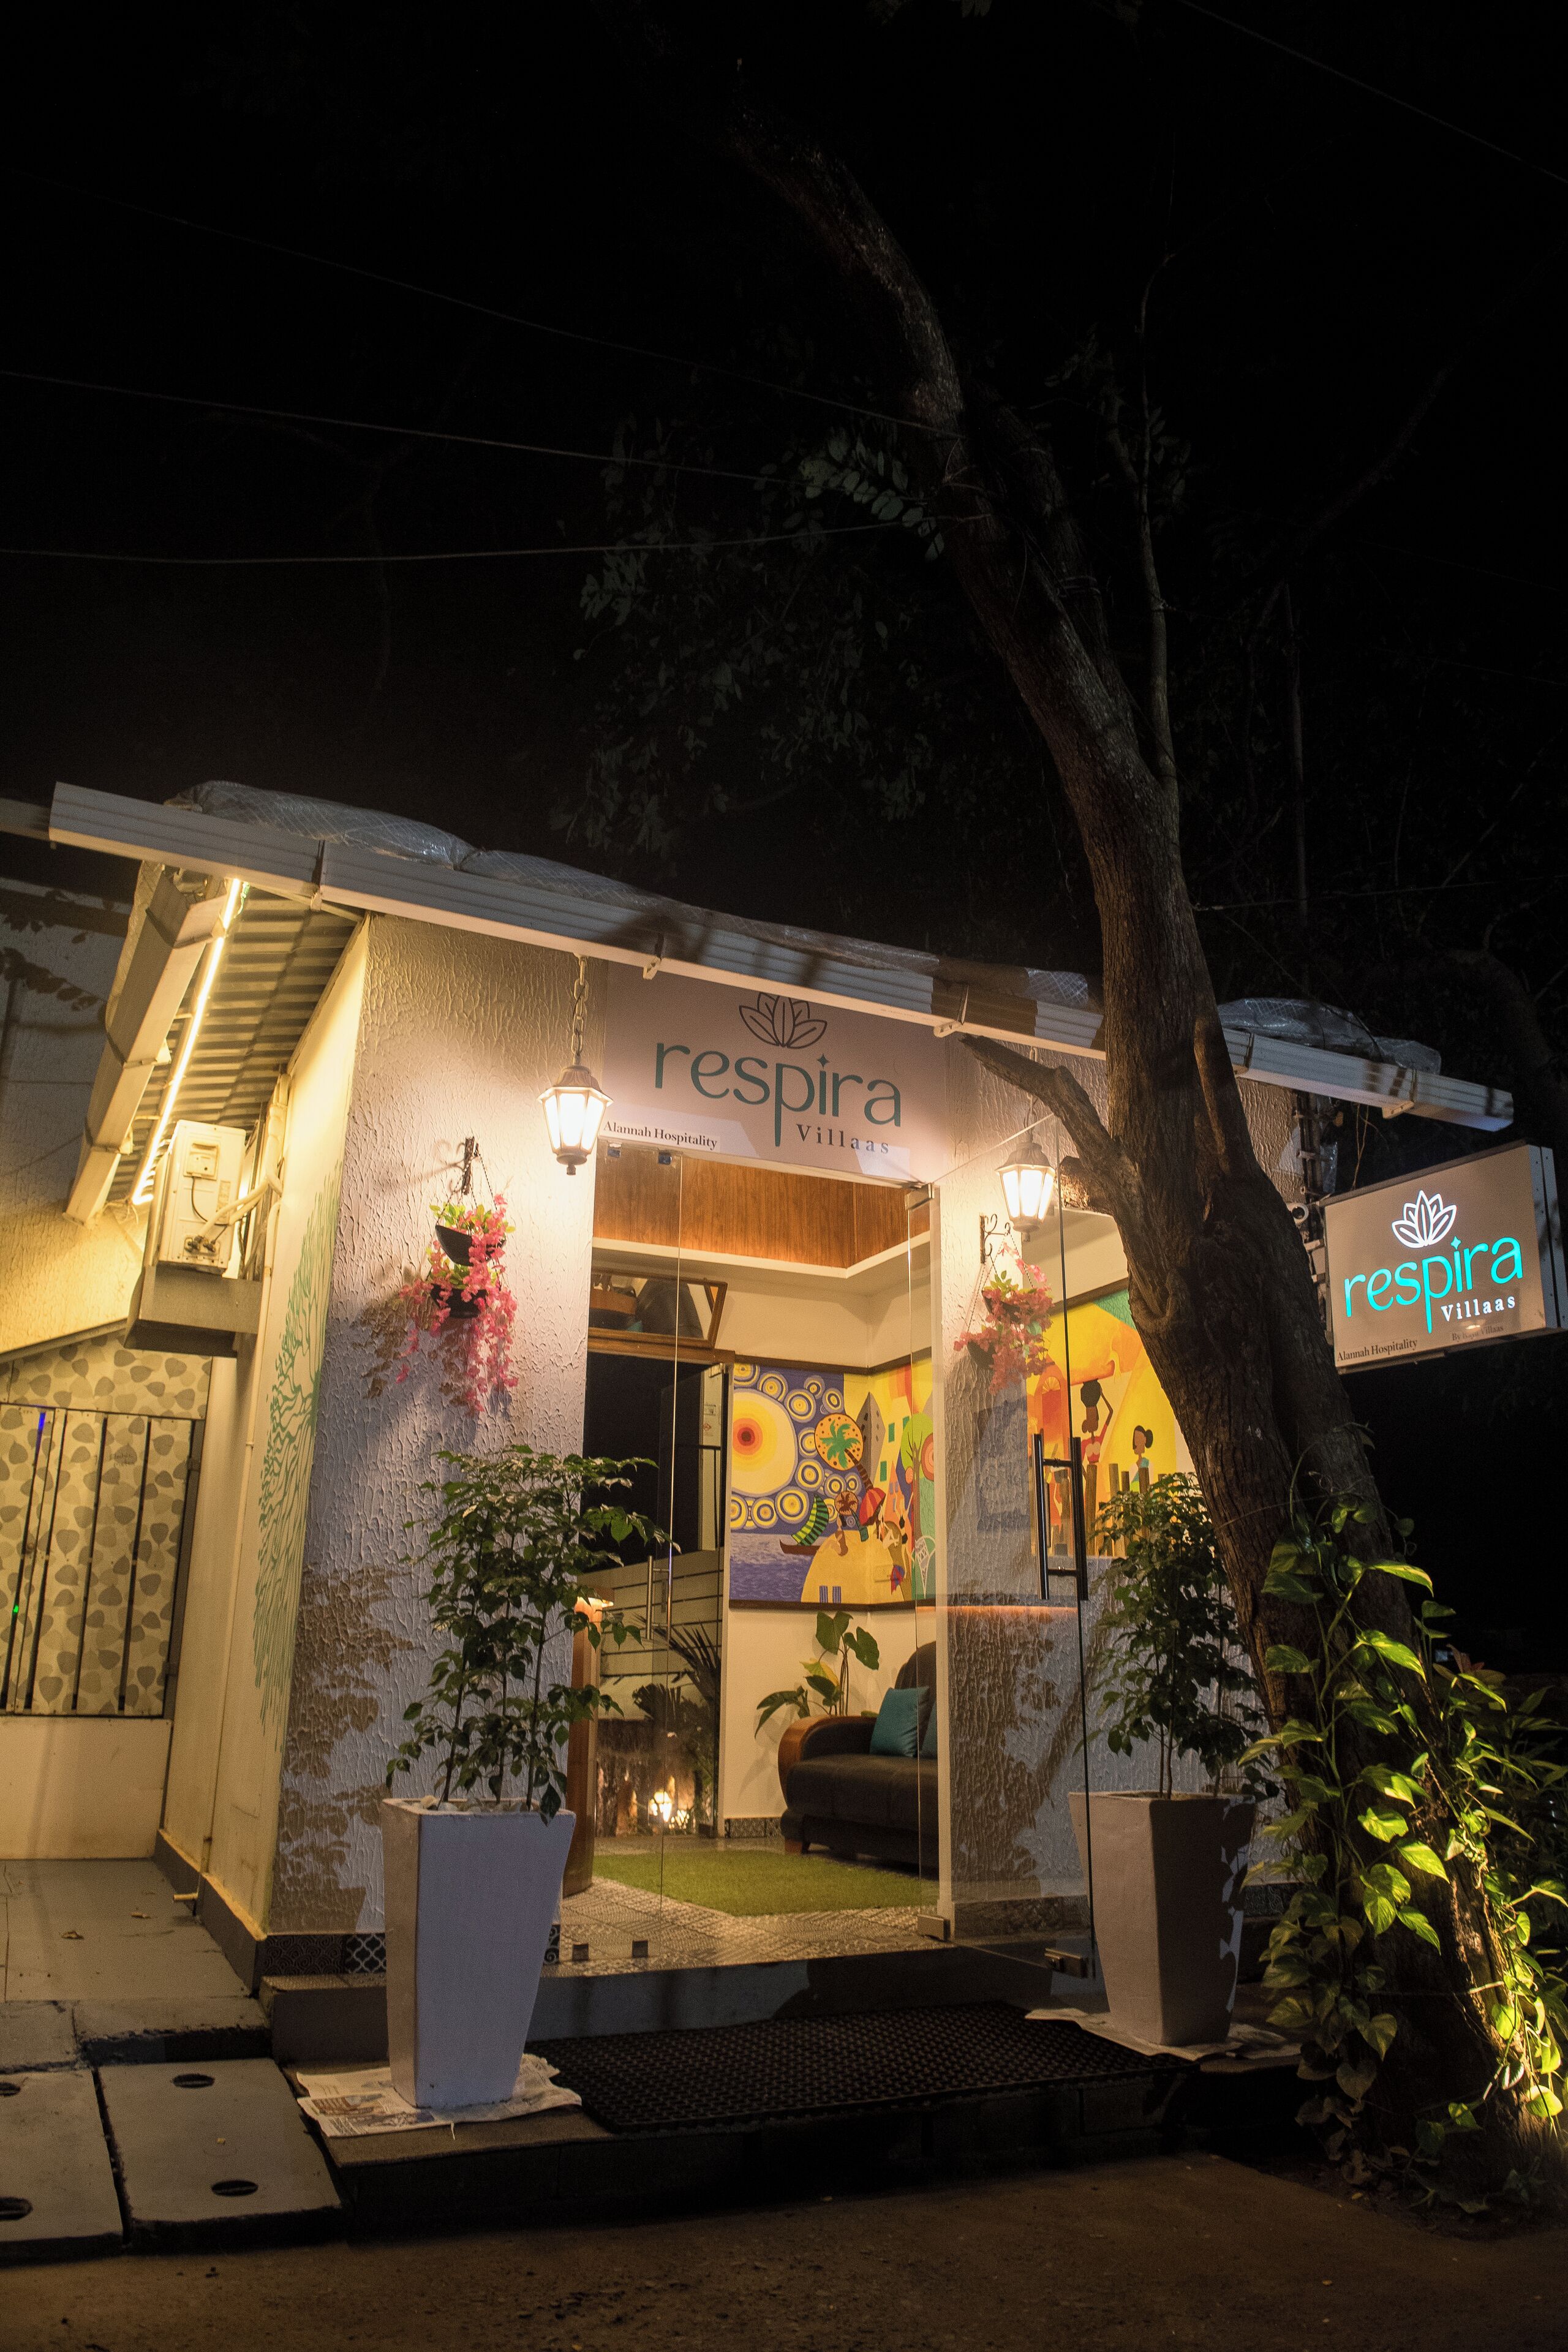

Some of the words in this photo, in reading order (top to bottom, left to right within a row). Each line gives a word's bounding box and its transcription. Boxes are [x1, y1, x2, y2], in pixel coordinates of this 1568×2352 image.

[655, 1042, 902, 1147] respira
[603, 1120, 651, 1137] Alannah
[654, 1128, 718, 1150] Hospitality
[796, 1123, 889, 1154] Villaas
[1344, 1236, 1524, 1333] respira
[1440, 1295, 1516, 1322] Villaas
[1337, 1346, 1370, 1361] Alannah
[1371, 1338, 1418, 1355] Hospitality
